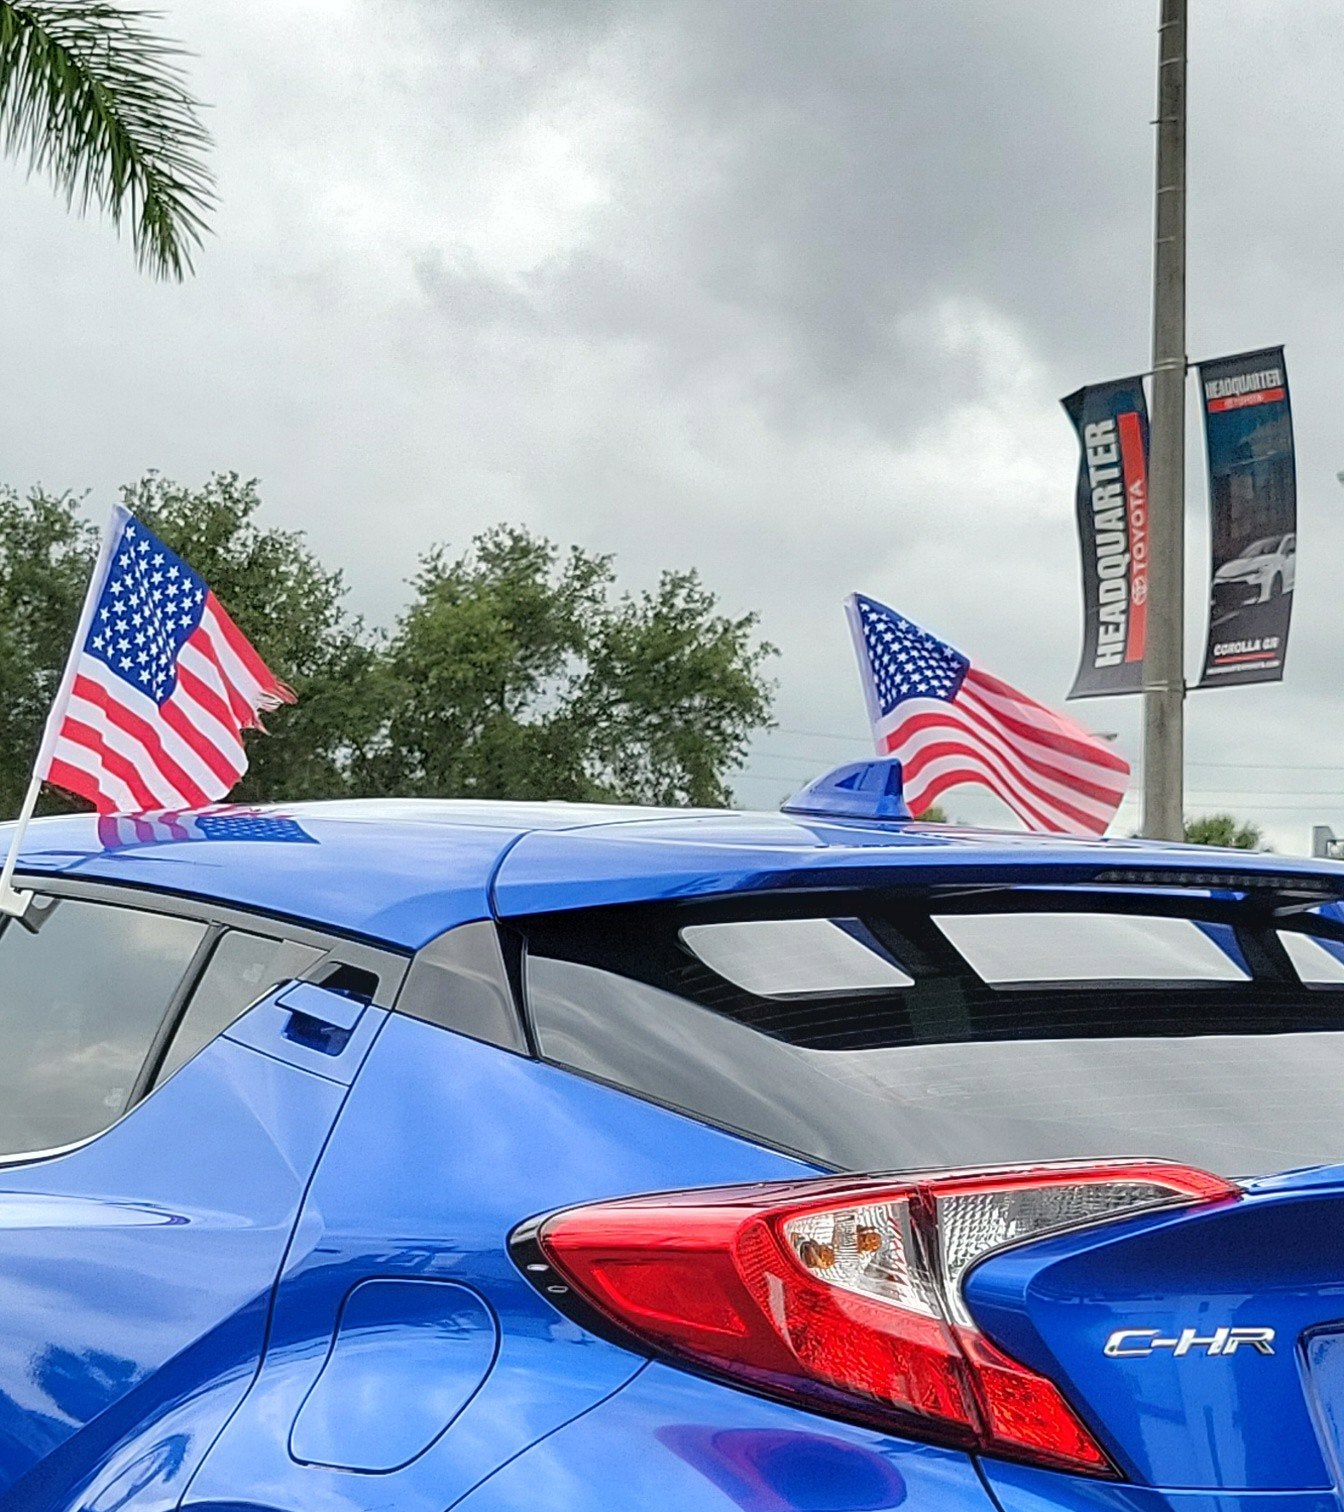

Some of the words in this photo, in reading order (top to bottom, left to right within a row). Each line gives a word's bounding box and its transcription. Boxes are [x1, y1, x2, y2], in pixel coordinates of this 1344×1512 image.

[1085, 418, 1131, 669] HEADQUARTER
[1129, 478, 1148, 573] TOYOTA
[1104, 1327, 1276, 1358] C-HR
